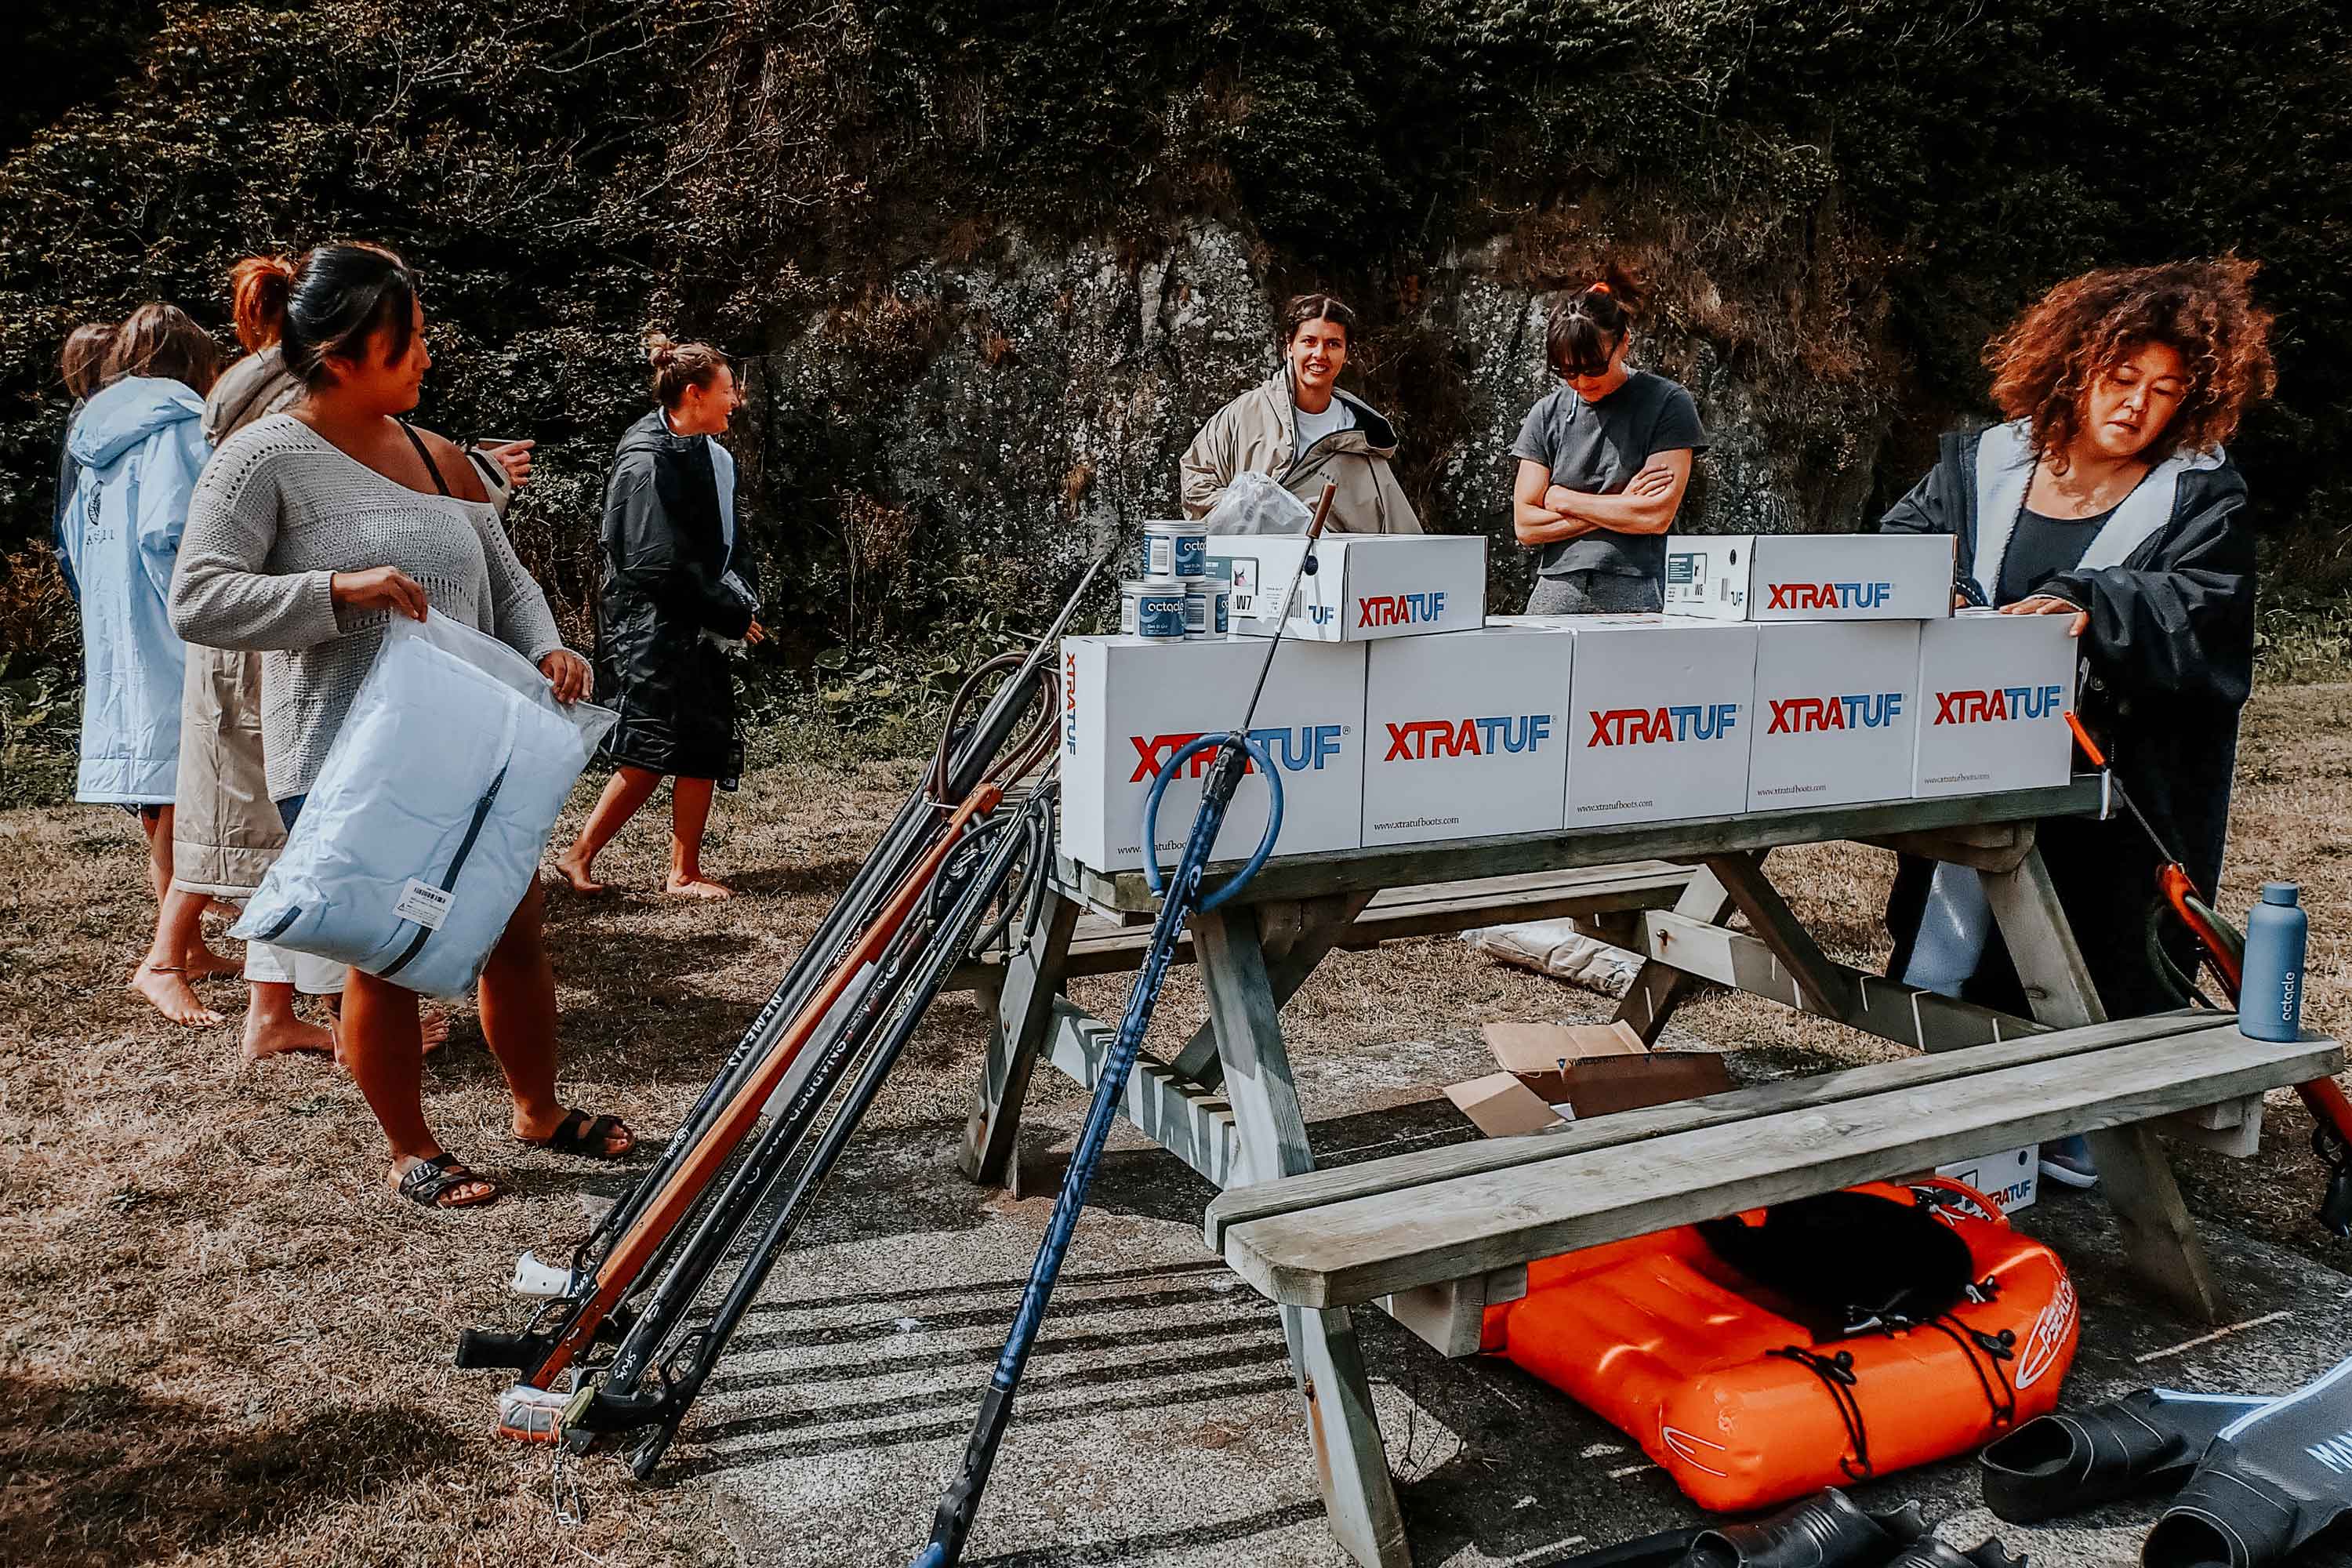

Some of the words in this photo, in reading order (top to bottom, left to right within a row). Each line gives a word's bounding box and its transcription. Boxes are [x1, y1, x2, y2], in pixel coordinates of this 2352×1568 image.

[1236, 595, 1253, 610] W7
[1357, 593, 1444, 628] XTRATUF
[1767, 583, 1890, 609] XTRATUF
[1066, 652, 1076, 756] XTRATUF
[1767, 693, 1902, 735] XTRATUF
[1933, 685, 2061, 725] XTRATUF
[1384, 715, 1551, 761] XTRATUF
[1587, 704, 1737, 747] XTRATUF
[1576, 799, 1653, 813] www.xtratufboots.com
[1756, 784, 1828, 797] www.xtratufboots.com
[1374, 816, 1459, 831] www.xtratufboots.com
[728, 993, 784, 1069] NEMESIS
[1987, 1179, 2032, 1206] TRATUF
